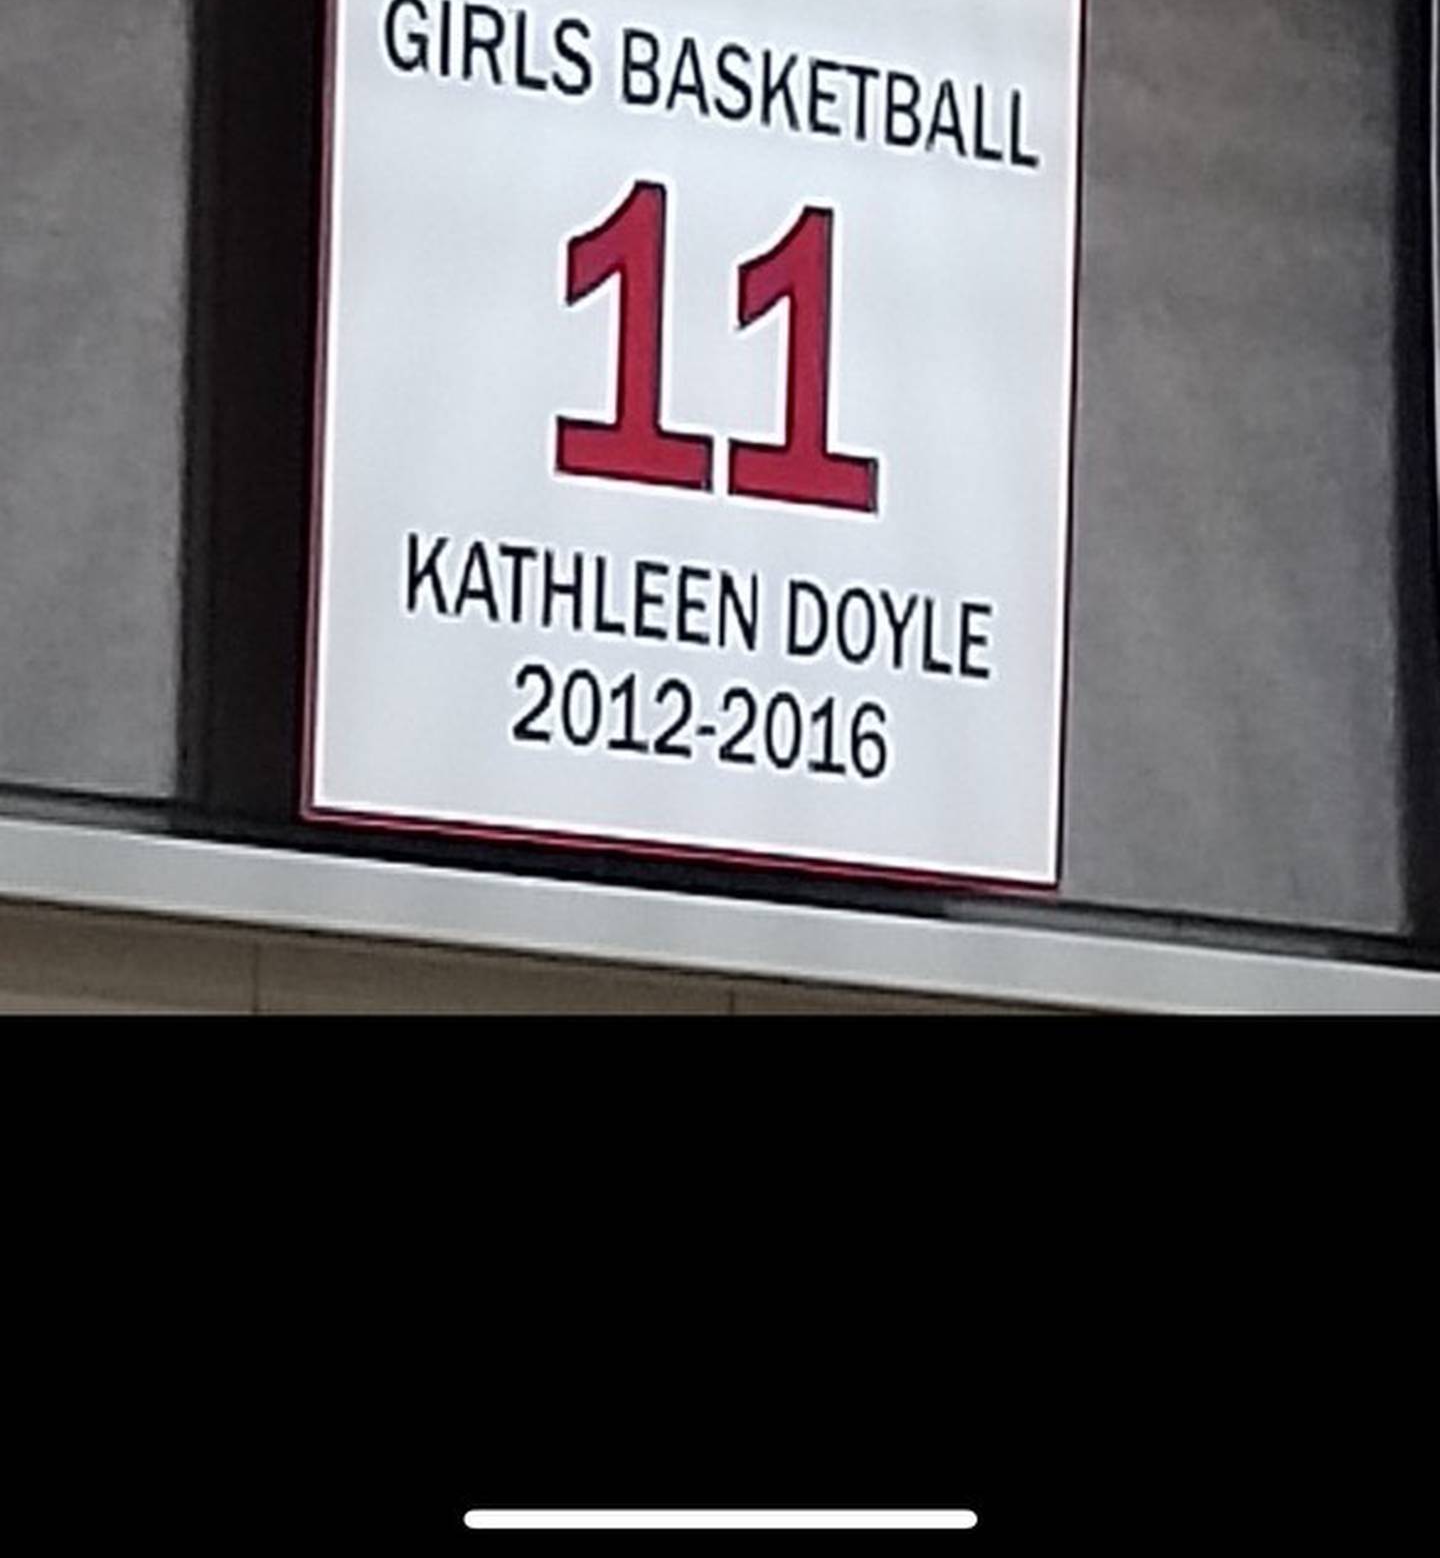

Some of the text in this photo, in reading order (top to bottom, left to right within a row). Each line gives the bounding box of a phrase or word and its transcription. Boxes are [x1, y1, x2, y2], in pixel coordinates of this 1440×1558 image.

[621, 28, 1040, 168] BASKETBALL
[554, 180, 879, 514] 11
[406, 533, 993, 680] KATHLEEN DOYLE
[512, 664, 888, 779] 2012-2016
